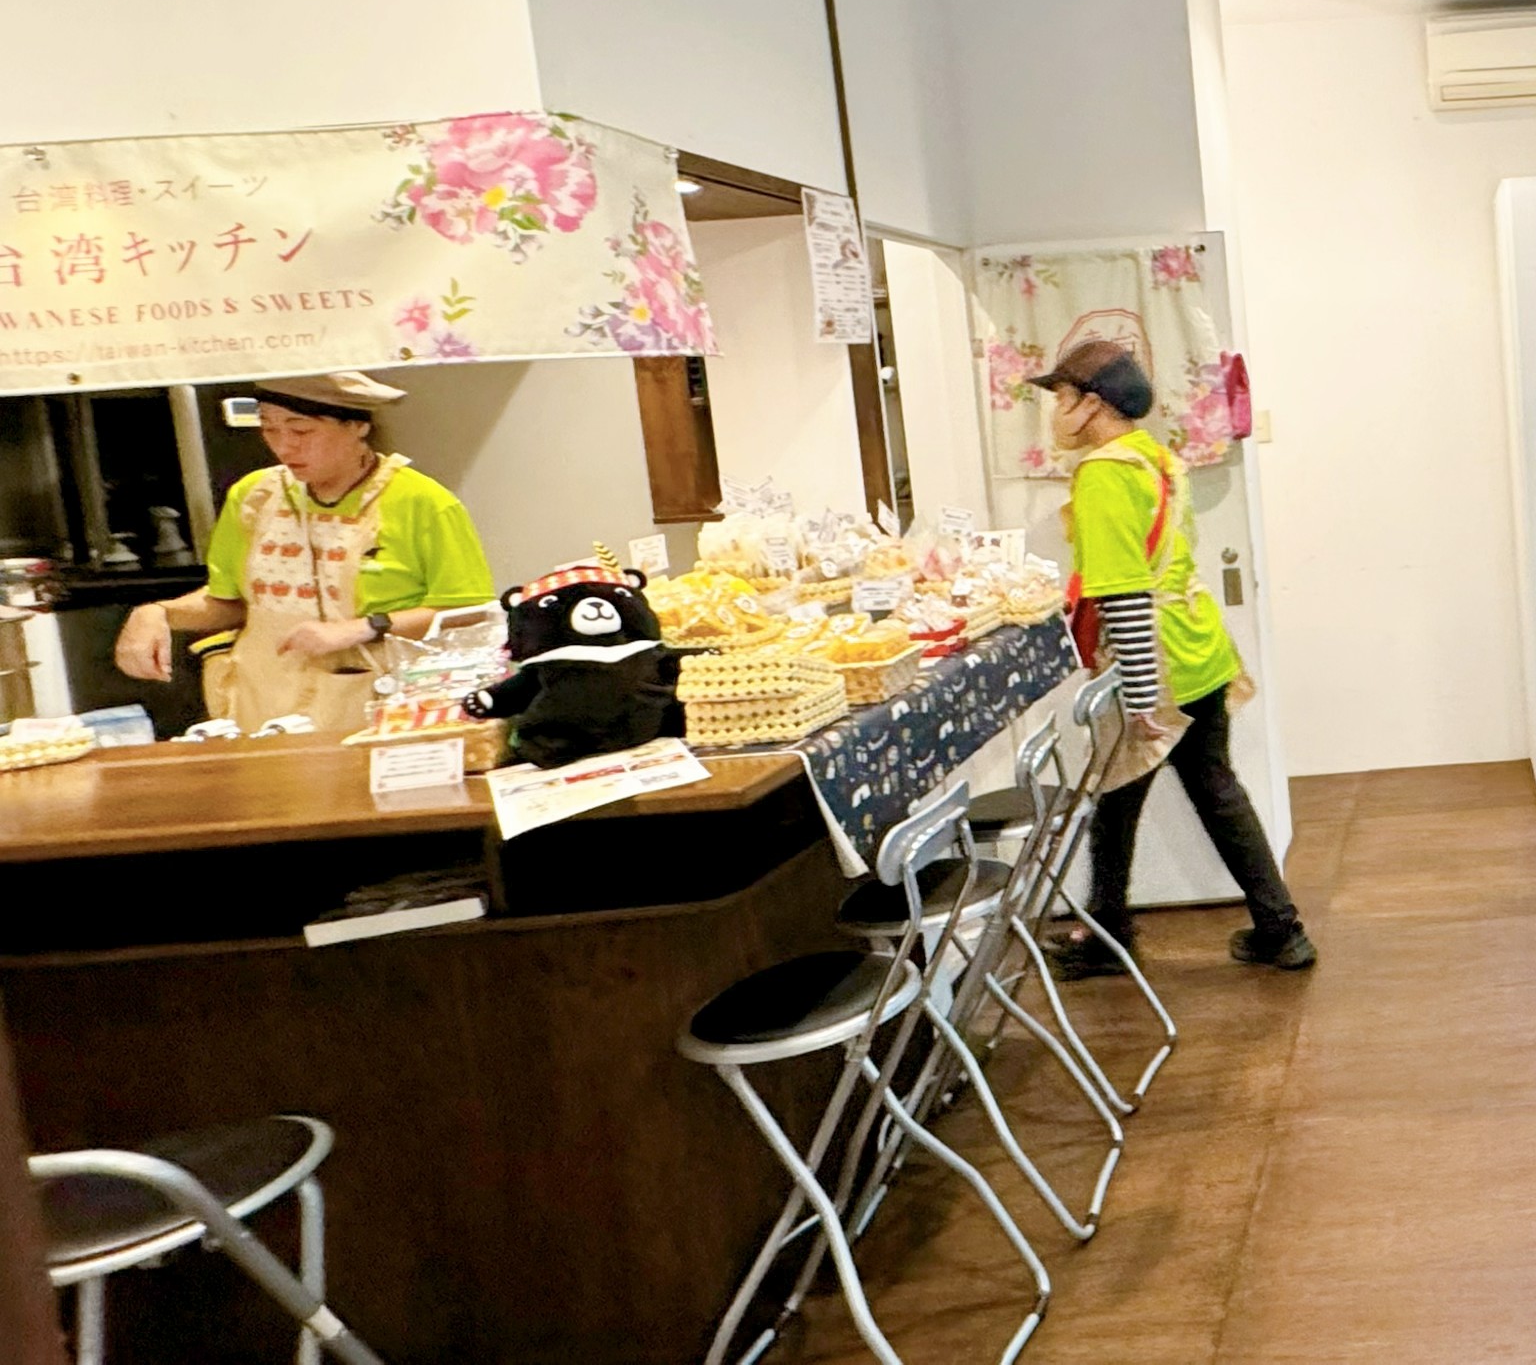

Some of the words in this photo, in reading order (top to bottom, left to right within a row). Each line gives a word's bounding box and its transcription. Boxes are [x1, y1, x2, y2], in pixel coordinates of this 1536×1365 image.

[11, 174, 270, 213] 台湾料理・スイーツ
[0, 221, 313, 288] 台湾キッチン
[136, 298, 213, 323] FOODS
[223, 297, 241, 315] &
[250, 288, 376, 314] SWEETS
